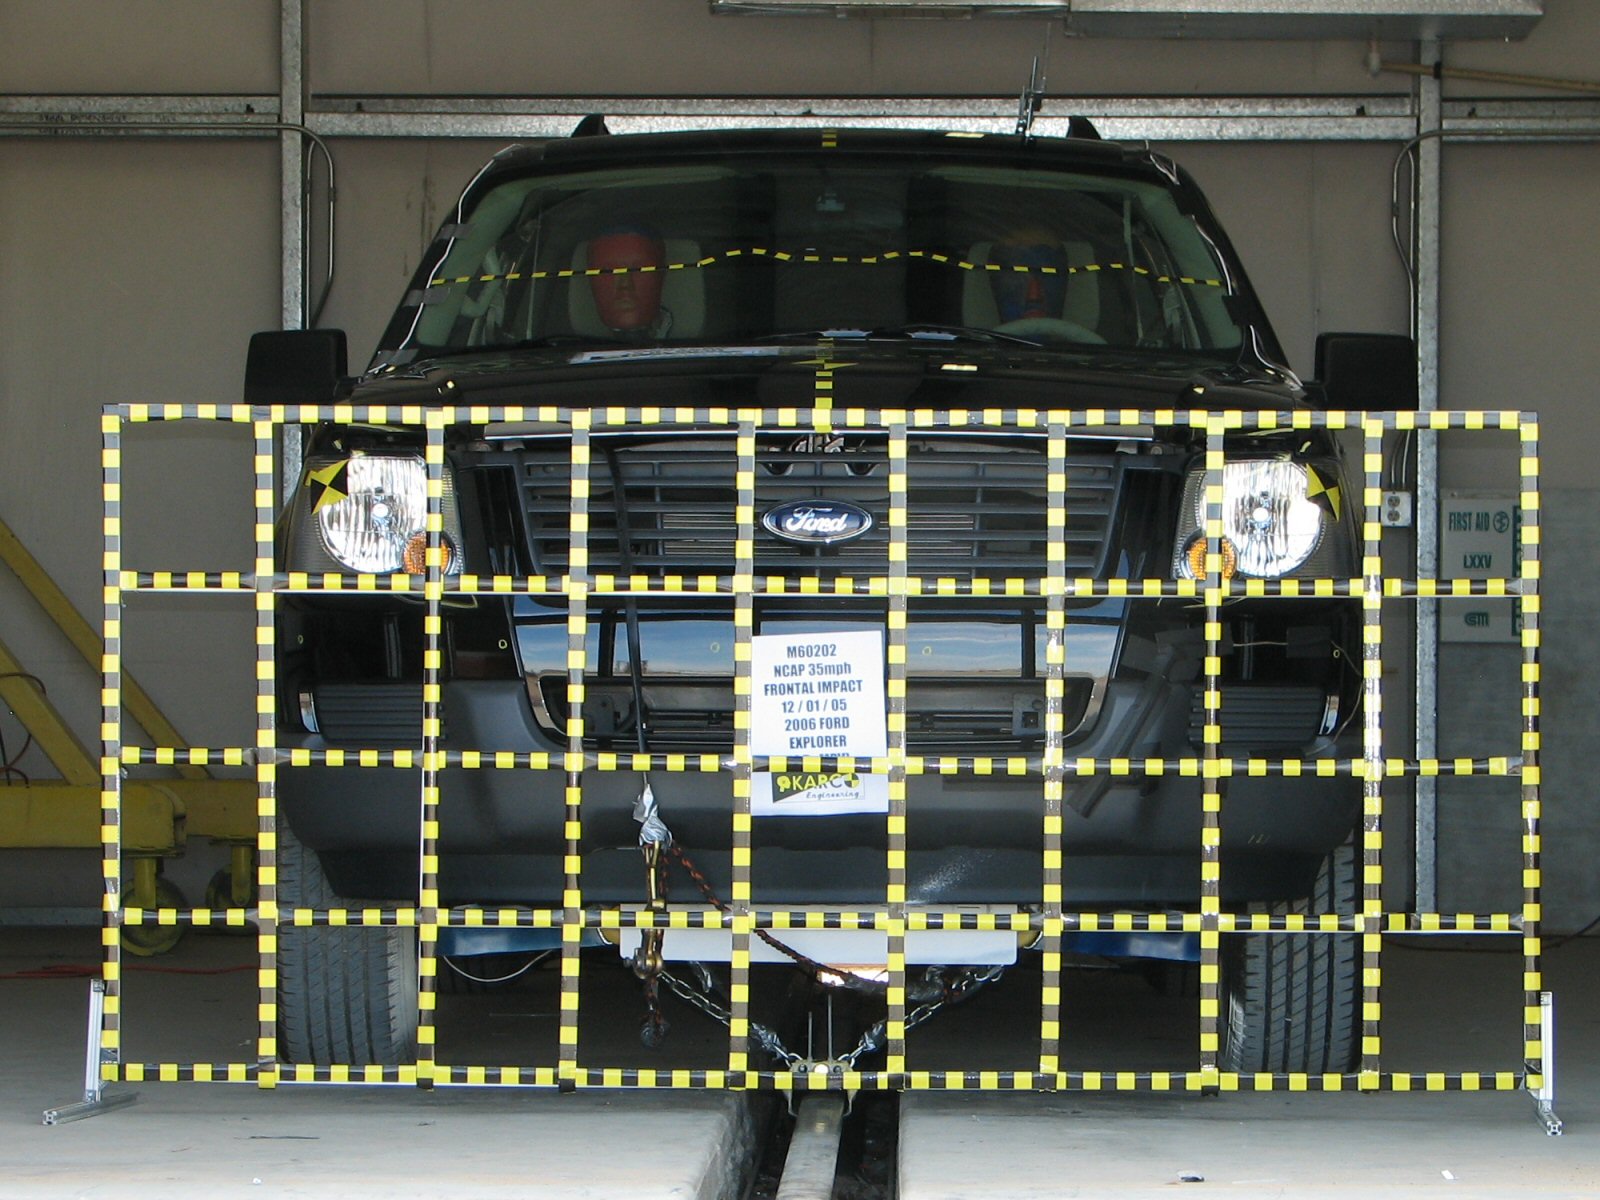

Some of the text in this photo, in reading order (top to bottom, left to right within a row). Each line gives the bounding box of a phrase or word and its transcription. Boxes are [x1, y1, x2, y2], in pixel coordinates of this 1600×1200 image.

[785, 507, 849, 532] Ford
[1449, 511, 1490, 531] FIRST AID
[787, 644, 837, 659] M60202
[774, 662, 852, 678] NCAP 35mph
[764, 680, 863, 696] FRONTAL IMPACT
[785, 717, 850, 732] 2006 FORD
[789, 735, 848, 750] EXPLORER
[806, 791, 861, 801] Engineering
